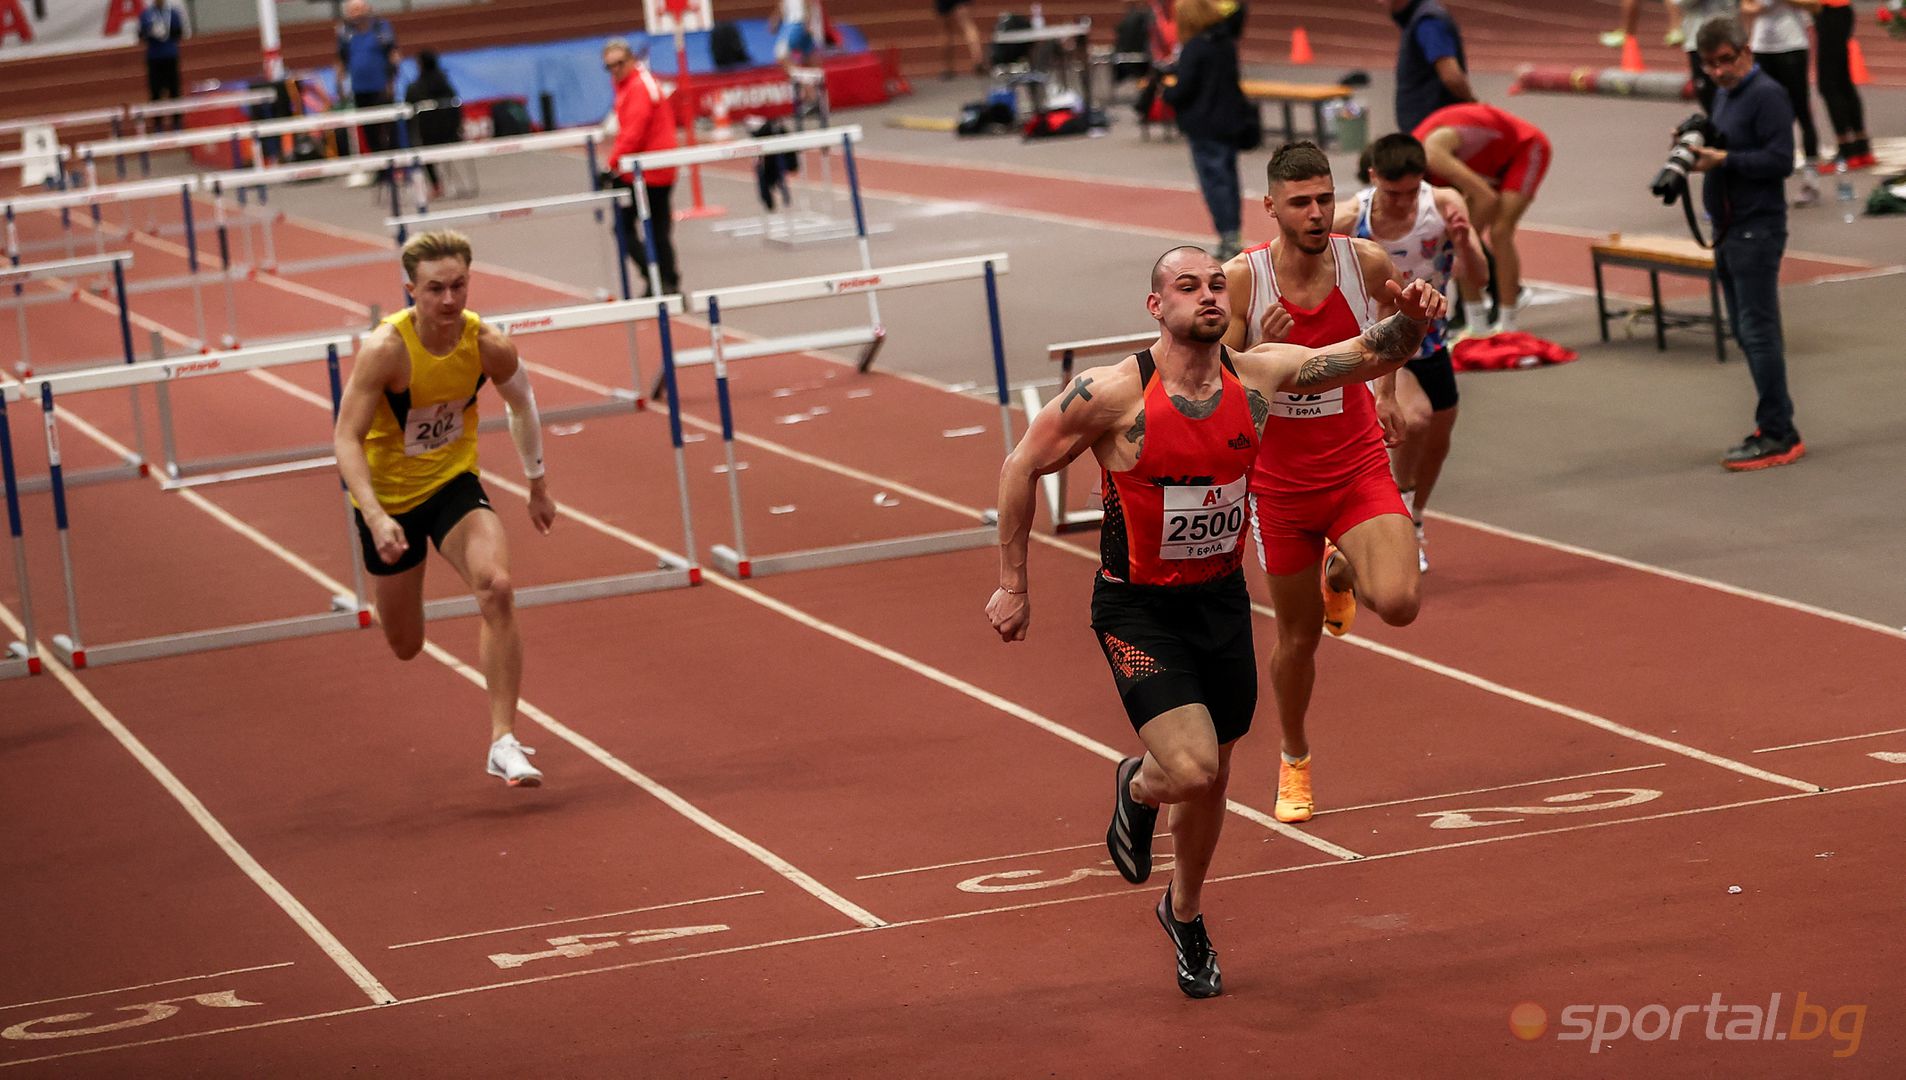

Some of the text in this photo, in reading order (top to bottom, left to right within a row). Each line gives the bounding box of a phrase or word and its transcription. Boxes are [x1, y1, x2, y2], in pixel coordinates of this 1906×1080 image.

[416, 412, 454, 440] 202
[1296, 406, 1321, 416] БФЛА
[1167, 506, 1242, 542] 2500
[1197, 543, 1223, 556] БФЛА
[1416, 788, 1664, 829] 2
[488, 924, 731, 969] 4
[0, 990, 264, 1041] 5
